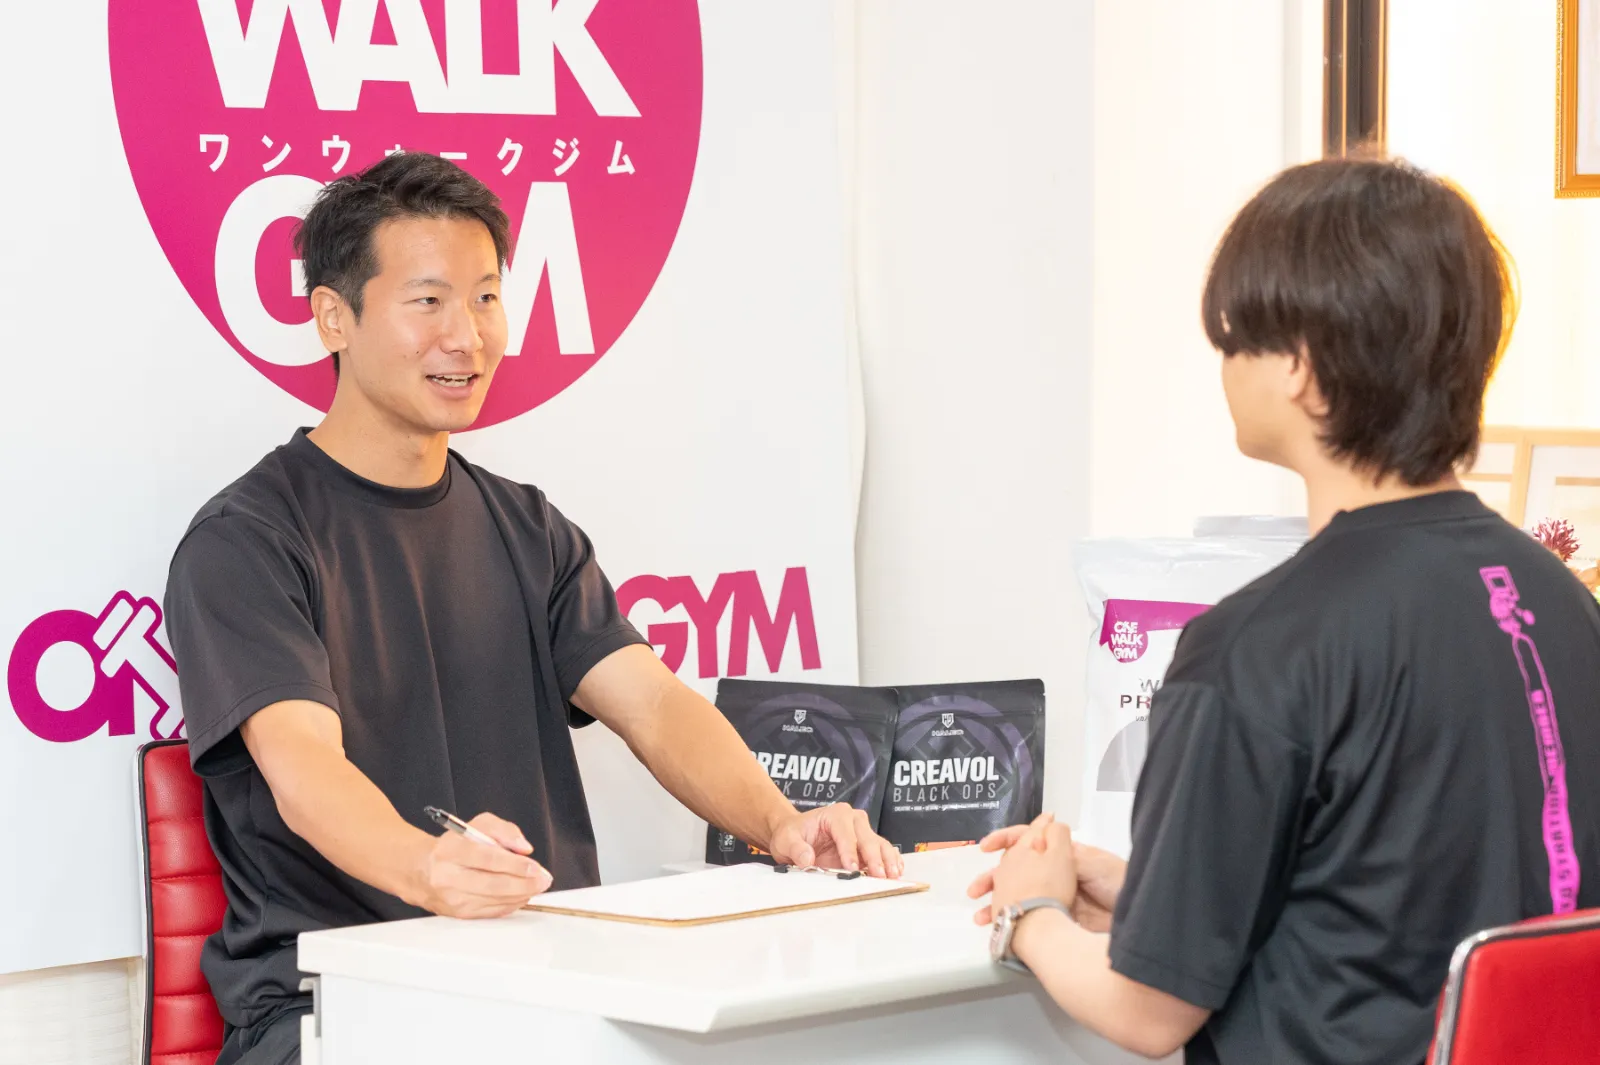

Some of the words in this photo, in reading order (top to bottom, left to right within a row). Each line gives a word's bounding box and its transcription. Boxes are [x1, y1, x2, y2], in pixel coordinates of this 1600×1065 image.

[198, 0, 641, 117] WALK
[214, 174, 595, 366] GM
[615, 566, 821, 679] GYM
[1110, 634, 1143, 647] WALK
[1113, 648, 1138, 659] GYM
[750, 751, 842, 783] REAVOL
[893, 756, 999, 786] CREAVOL
[802, 782, 836, 799] OPS
[893, 785, 950, 803] BLACK
[962, 782, 997, 800] OPS
